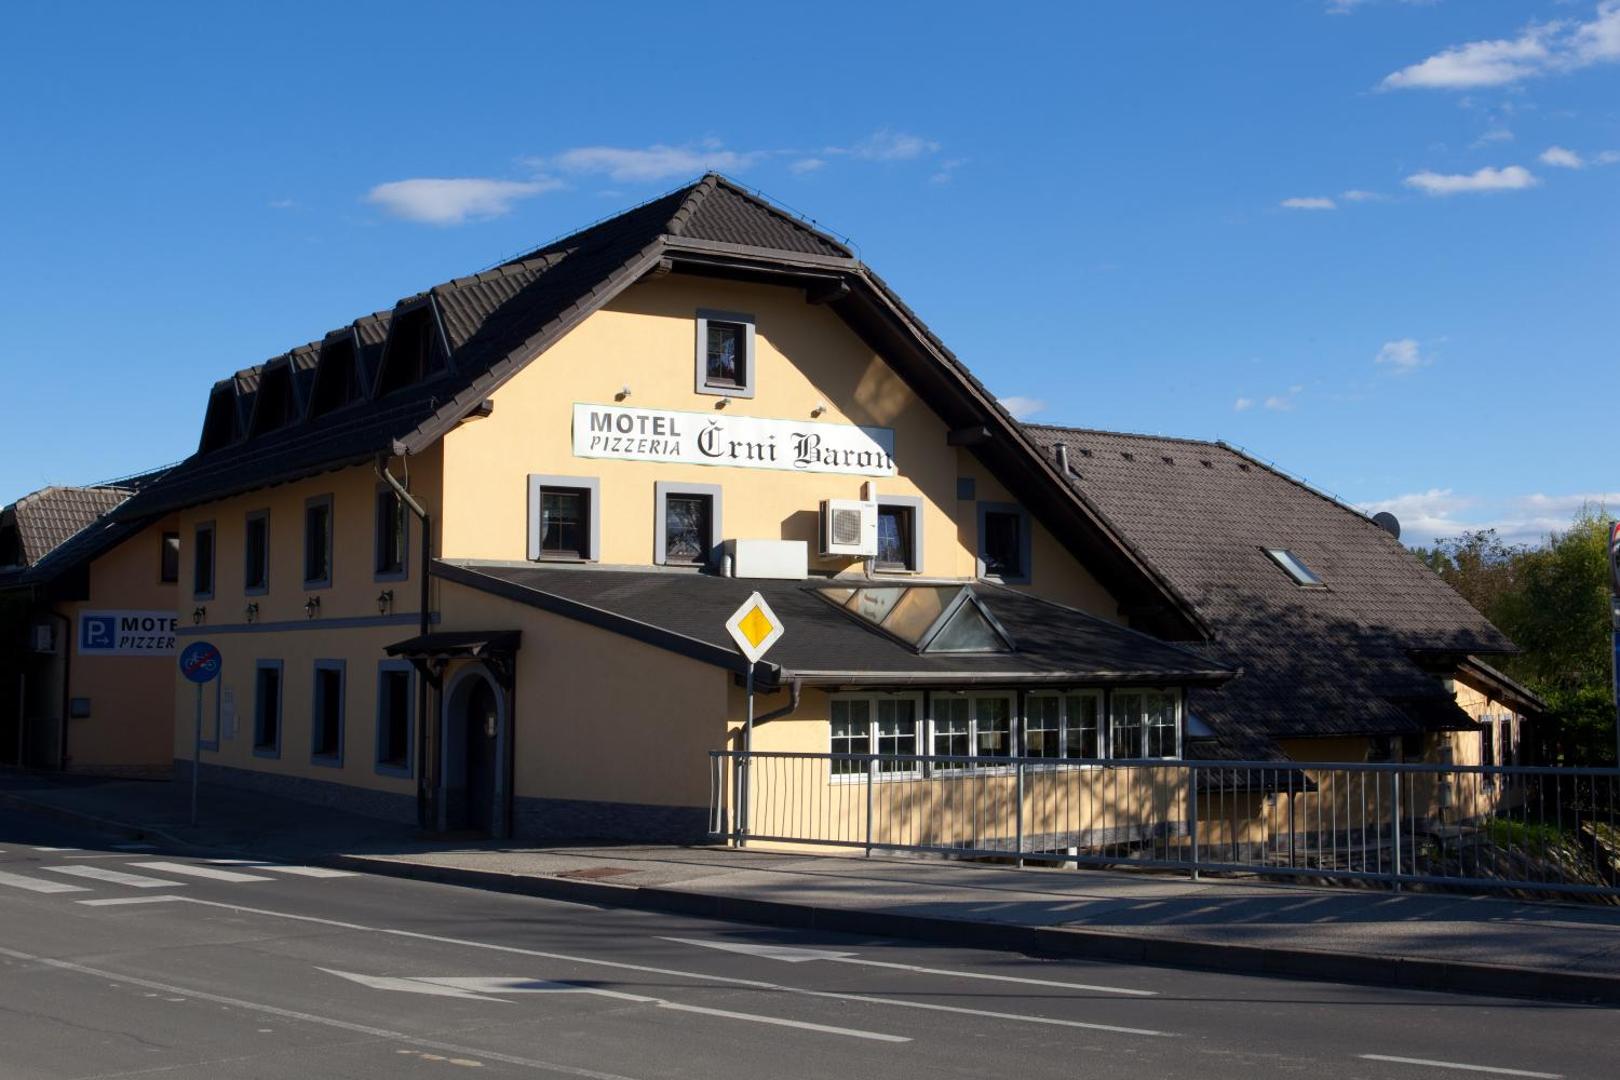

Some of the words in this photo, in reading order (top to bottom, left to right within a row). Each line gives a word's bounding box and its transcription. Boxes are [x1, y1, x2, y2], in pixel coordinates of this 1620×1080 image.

[590, 412, 681, 437] MOTEL
[589, 435, 681, 456] PIZZERIA
[697, 419, 777, 462] Črni
[790, 432, 893, 469] Baron
[87, 620, 106, 645] P
